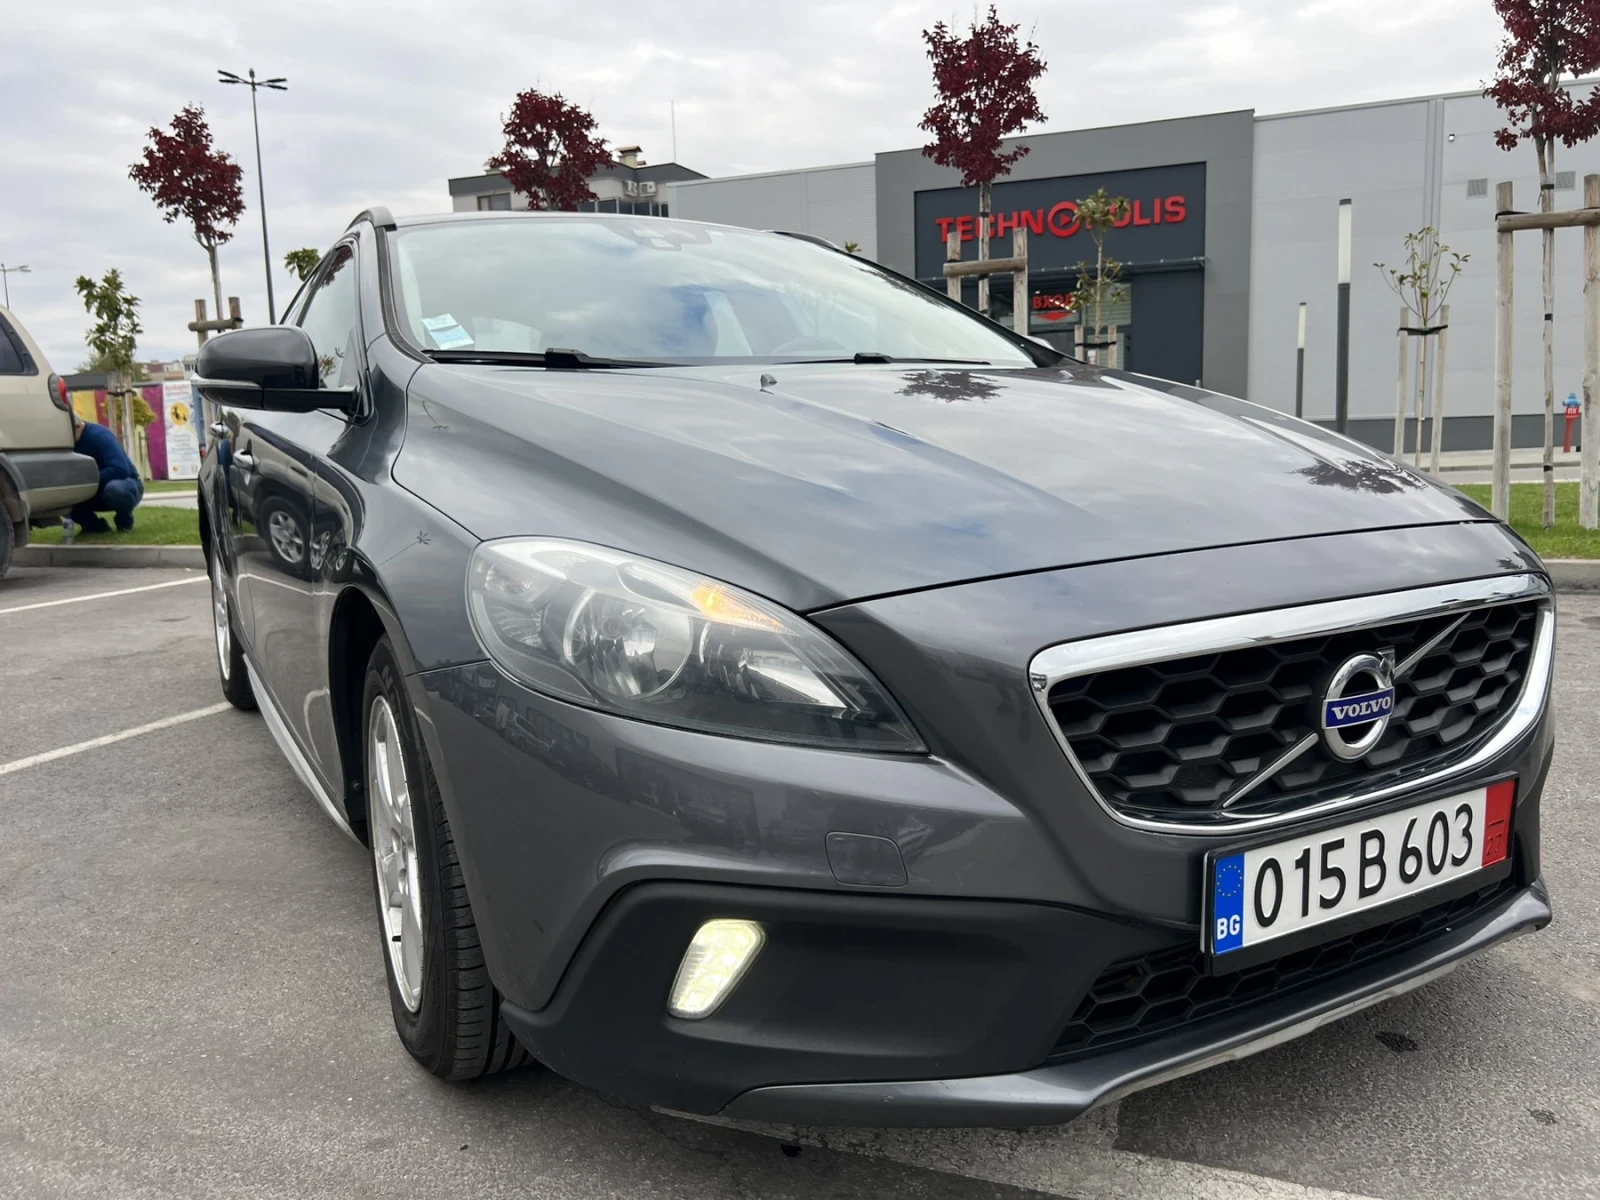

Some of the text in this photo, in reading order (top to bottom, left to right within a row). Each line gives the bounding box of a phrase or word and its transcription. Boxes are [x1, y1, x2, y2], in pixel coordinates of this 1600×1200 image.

[936, 195, 1187, 242] TECHNOOLIS
[1332, 696, 1391, 720] VOLVO
[1485, 832, 1503, 856] 27
[1216, 914, 1241, 940] BG
